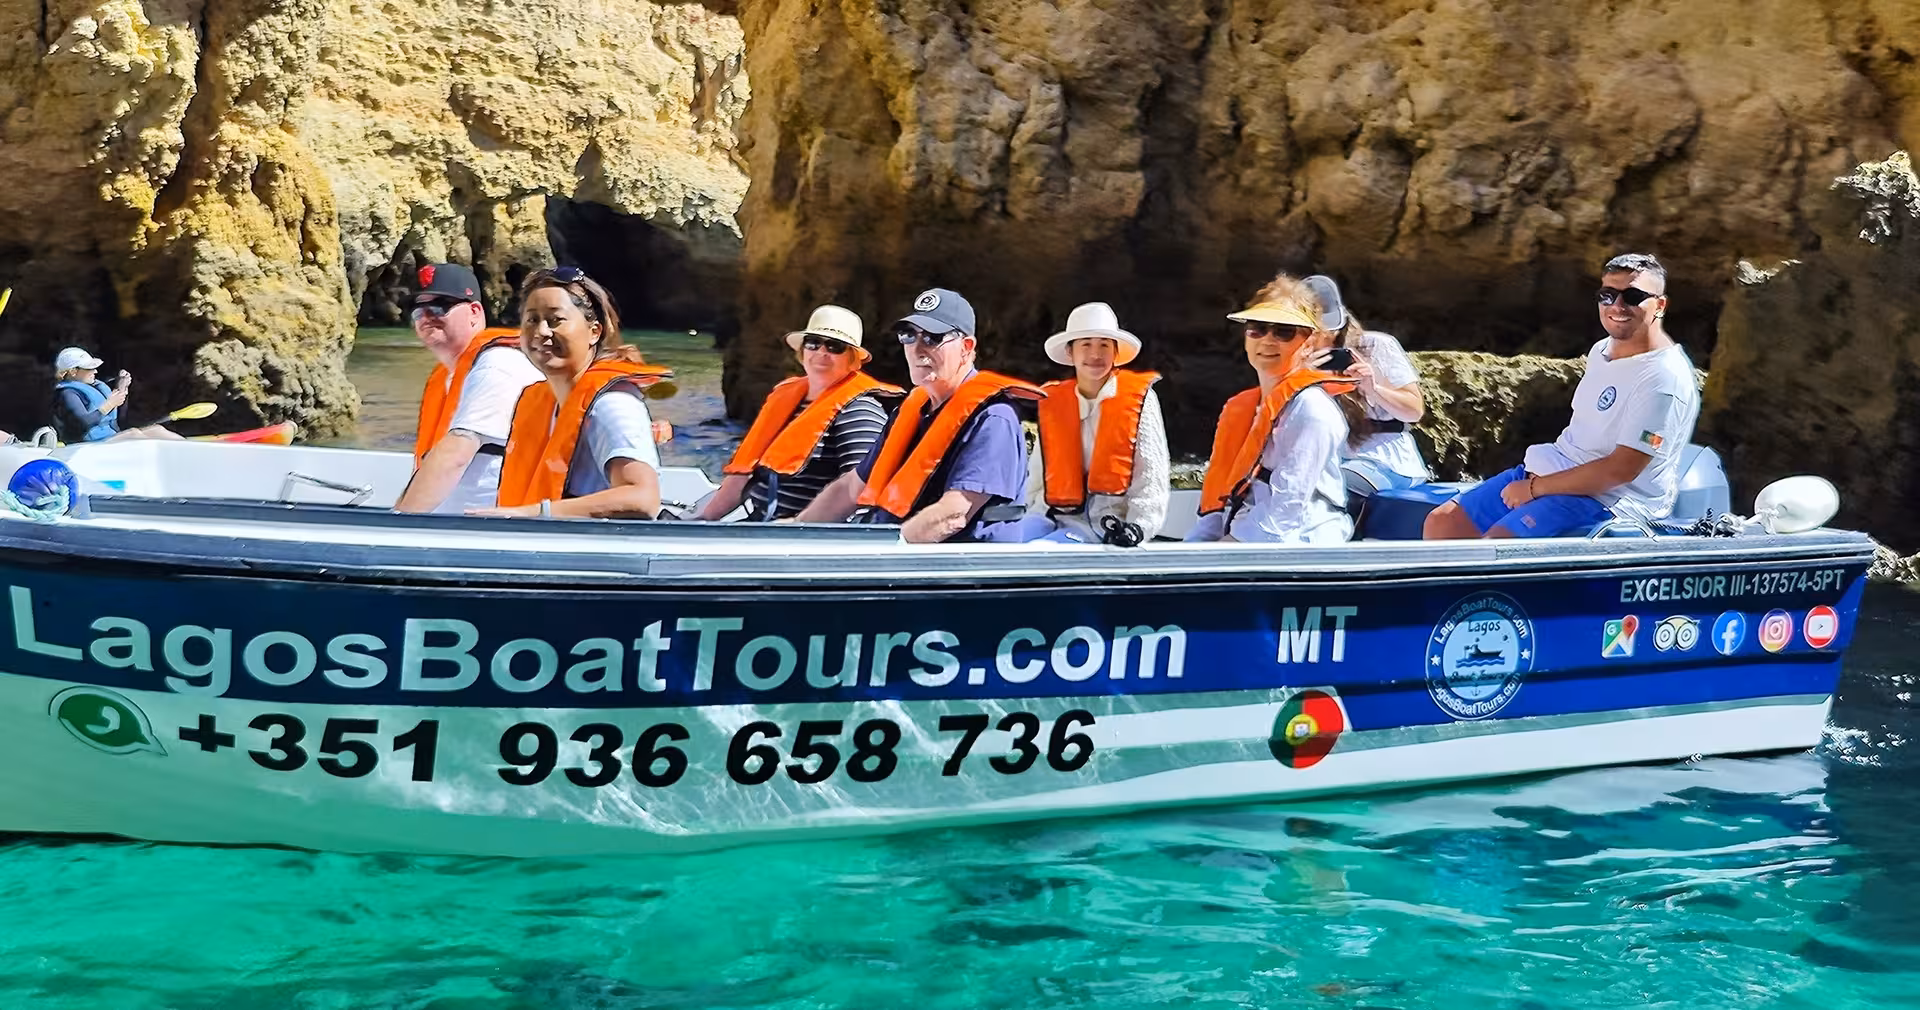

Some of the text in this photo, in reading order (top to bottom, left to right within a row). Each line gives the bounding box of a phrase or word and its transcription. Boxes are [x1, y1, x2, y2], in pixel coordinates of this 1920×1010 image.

[1620, 569, 1845, 602] EXCELSIOR III-137574-5PT
[10, 585, 1187, 697] LagosBoatTours.com
[1277, 606, 1358, 664] MT
[1434, 597, 1528, 645] LagosBoatTourscom
[1467, 621, 1501, 636] Lagos
[178, 709, 1096, 788] +351 936 658 736
